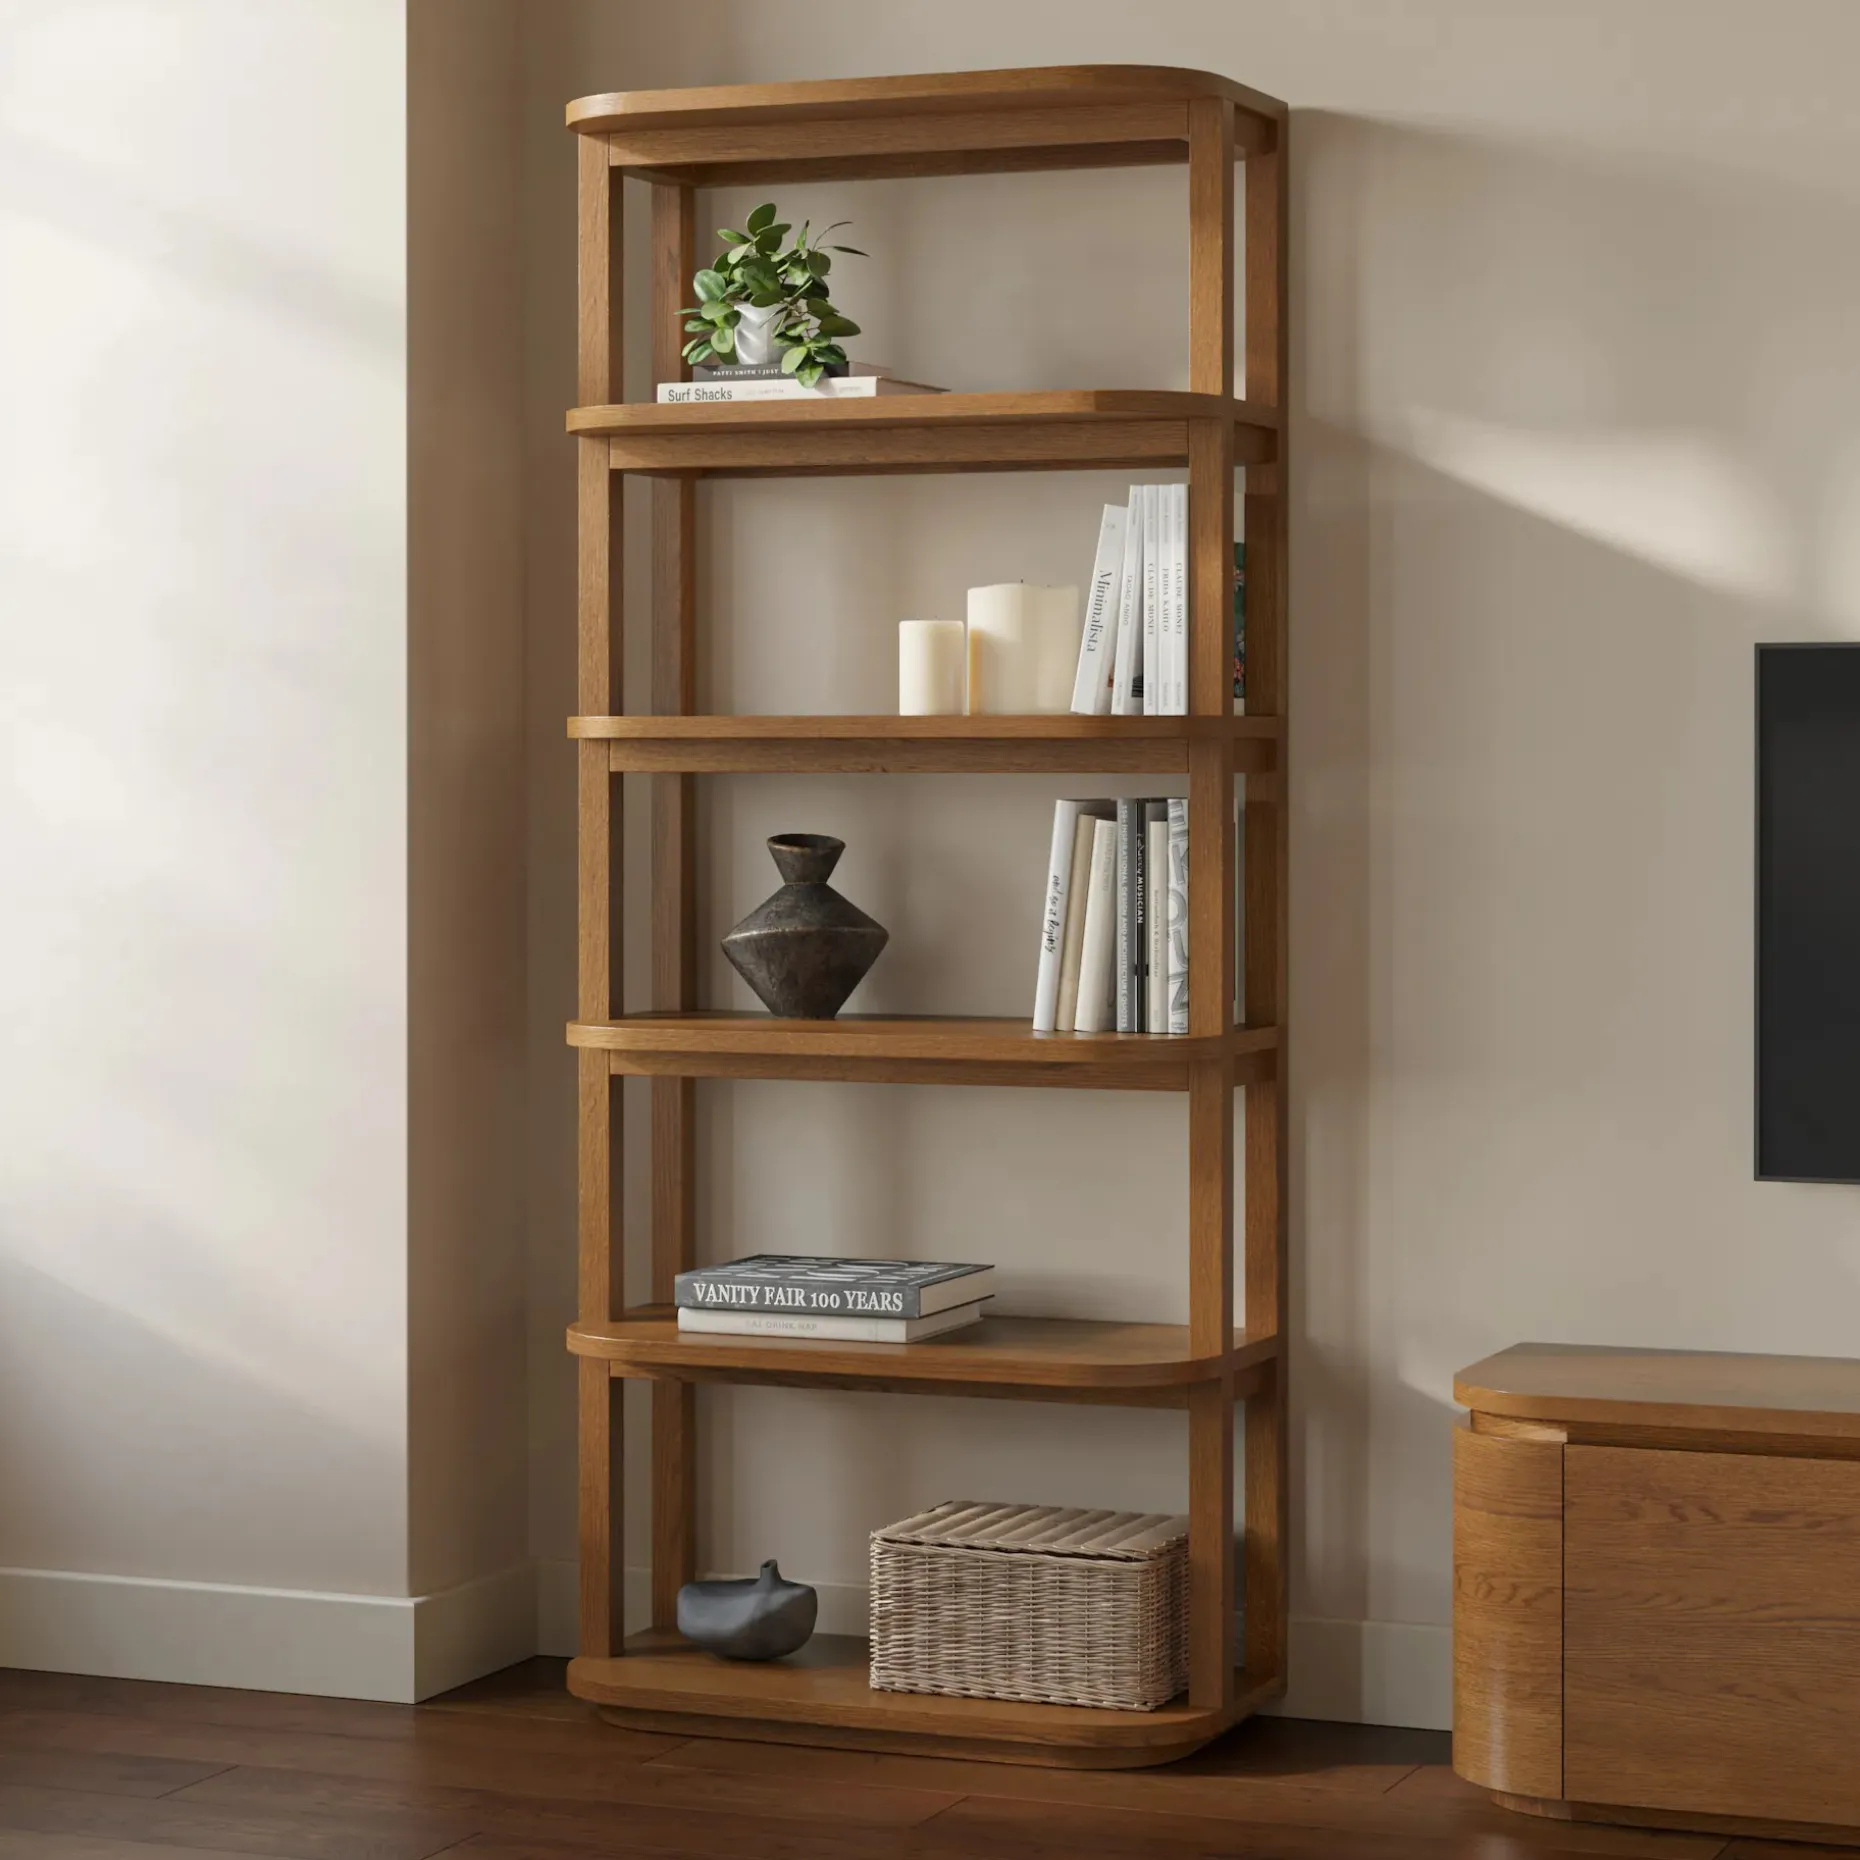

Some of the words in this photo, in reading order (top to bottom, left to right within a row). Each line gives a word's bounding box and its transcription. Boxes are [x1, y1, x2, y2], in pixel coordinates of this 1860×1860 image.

[668, 388, 691, 402] Surf
[694, 386, 733, 401] Shacks
[1162, 568, 1170, 596] FRIDA
[1086, 569, 1113, 653] Minimalista
[1123, 603, 1132, 626] ANDO
[1147, 604, 1155, 635] MONET
[1162, 600, 1170, 632] KAHLO
[1121, 824, 1129, 884] INSPIRATIONAL
[1052, 875, 1064, 895] and
[1048, 908, 1058, 917] it
[1121, 886, 1129, 916] DESIGN
[1121, 917, 1129, 935] AND
[1121, 935, 1129, 993] ARCHITECTURE
[1121, 994, 1129, 1028] QUOTES
[693, 1282, 761, 1305] VANITY
[764, 1286, 807, 1307] FAIR
[811, 1292, 841, 1308] 100
[844, 1290, 903, 1312] YEARS
[765, 1320, 796, 1330] DRINK
